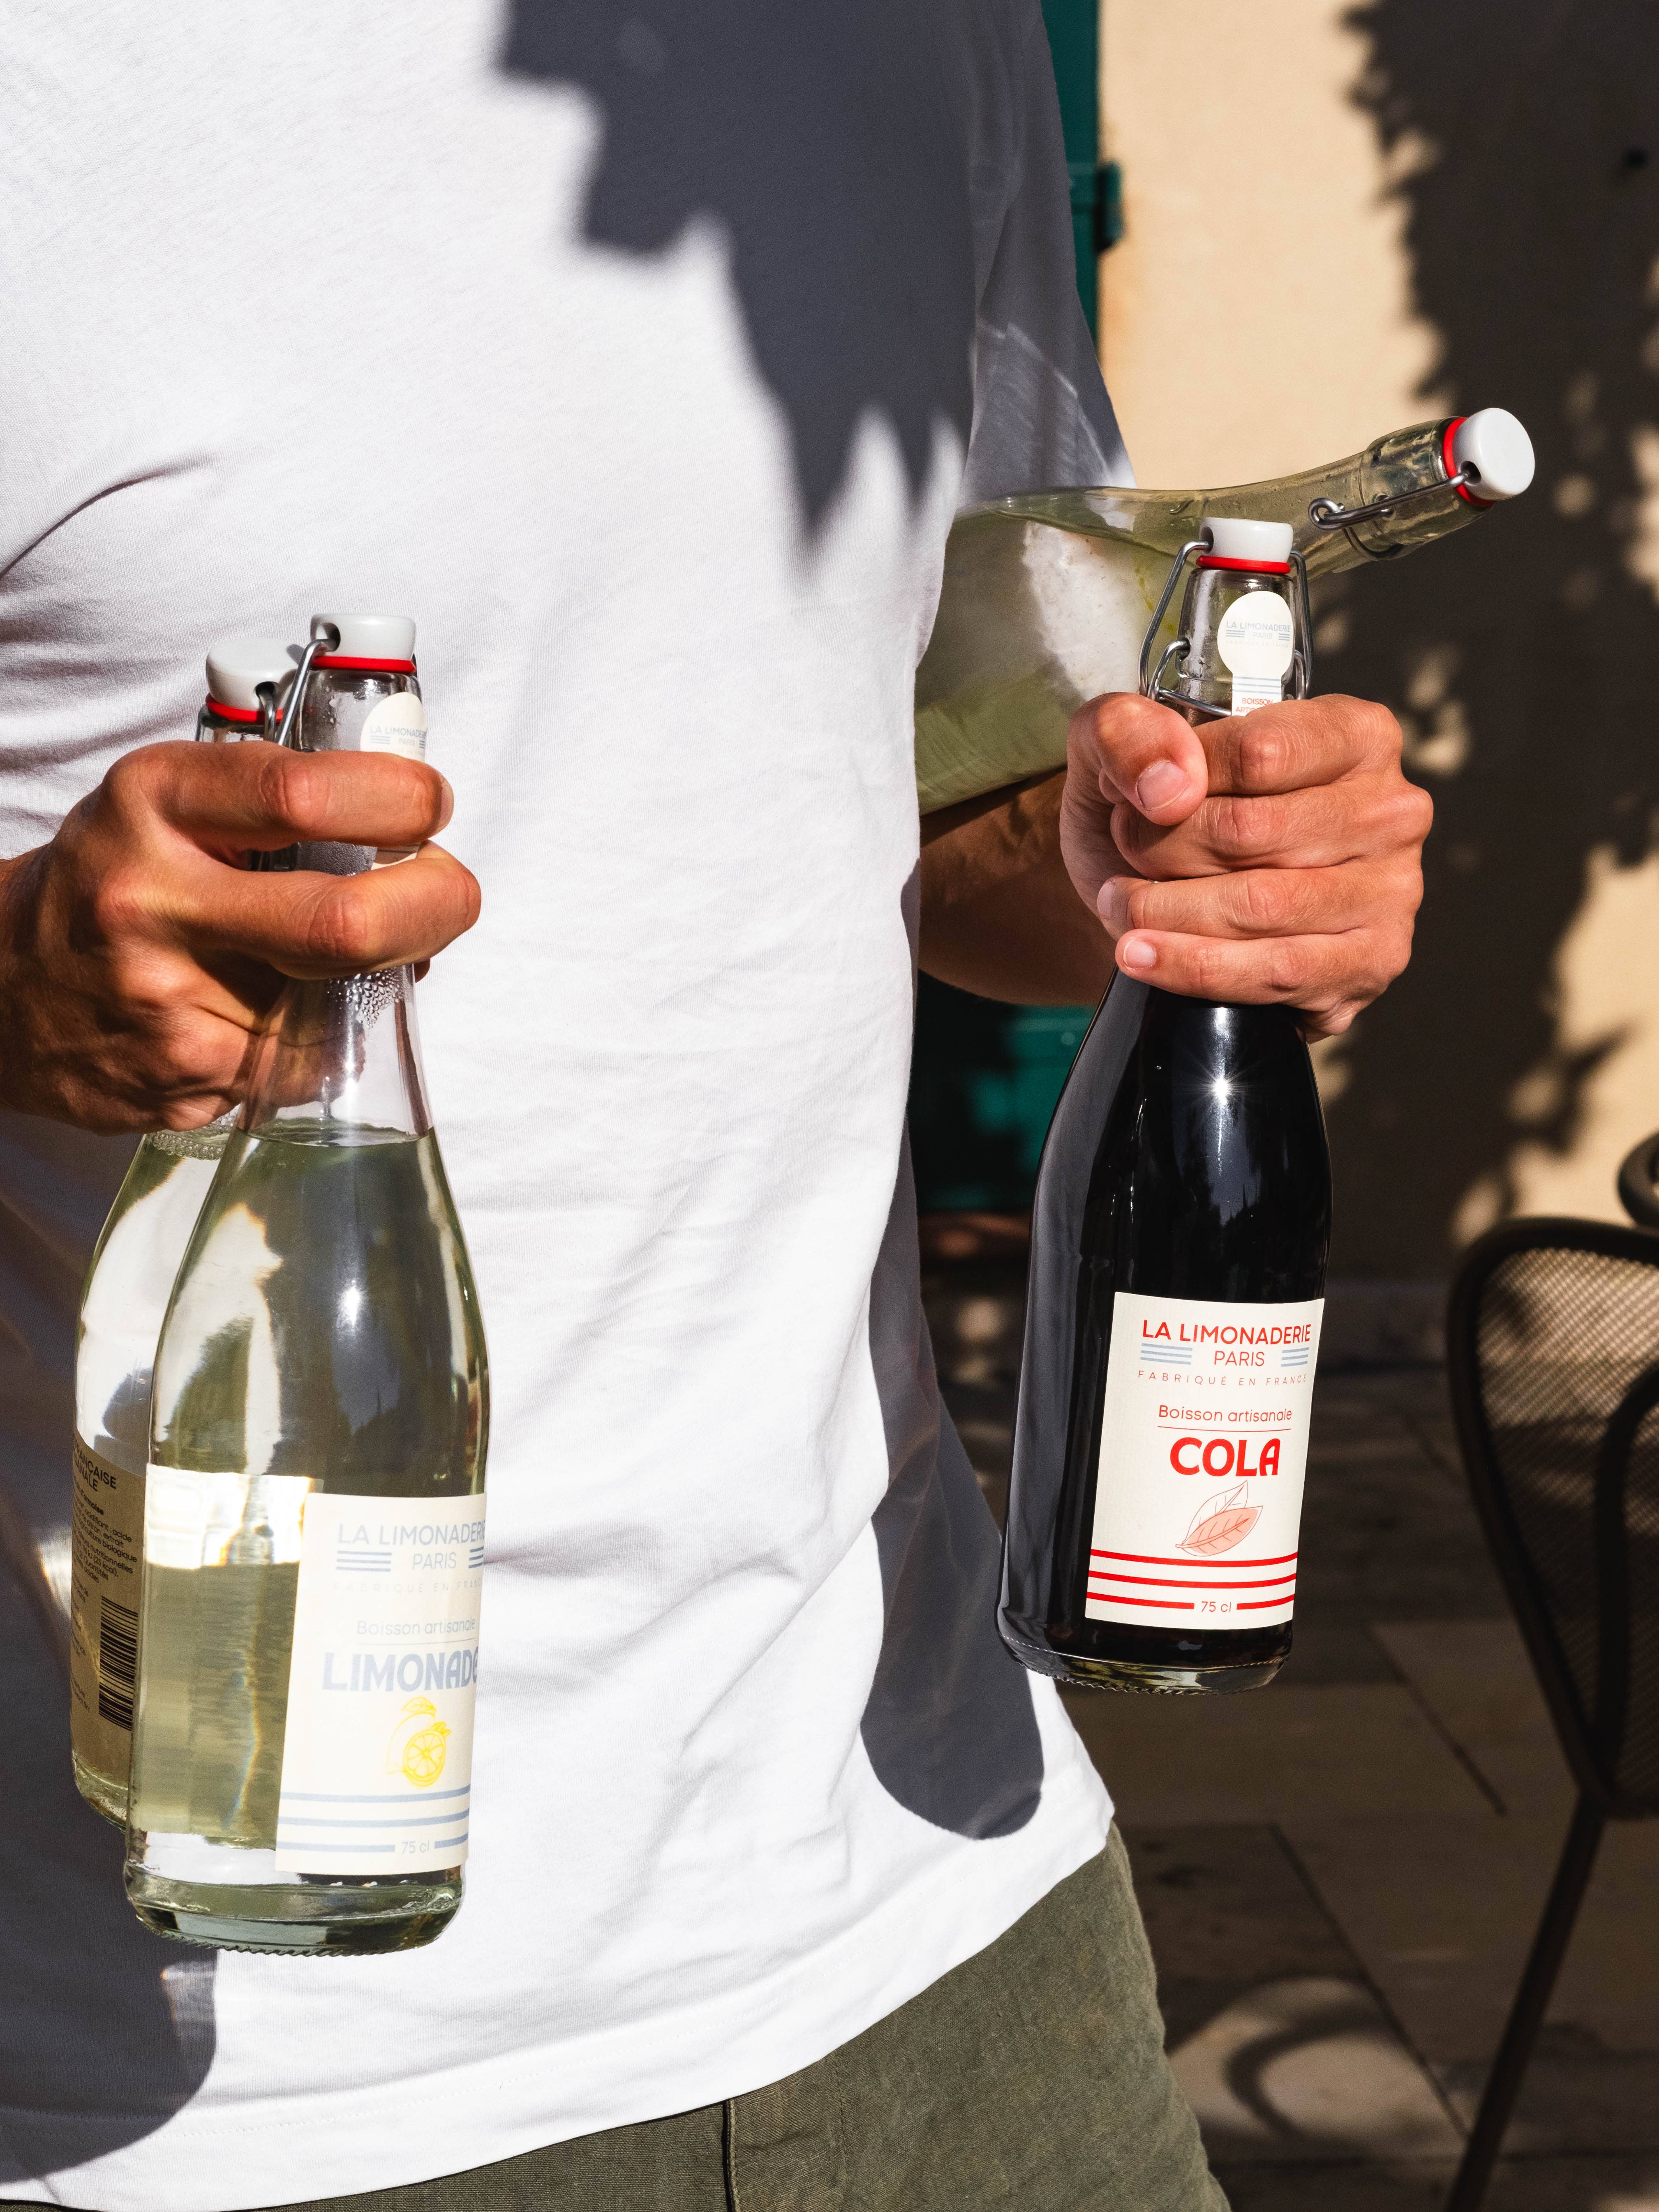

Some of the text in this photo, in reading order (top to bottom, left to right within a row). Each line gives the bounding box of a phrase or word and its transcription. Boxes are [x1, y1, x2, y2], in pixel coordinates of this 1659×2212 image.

[1240, 621, 1291, 632] LIMONADERIE
[370, 725, 381, 734] LA
[1142, 1319, 1311, 1345] LA LIMONADERIE
[1213, 1350, 1265, 1367] PARIS
[1138, 1369, 1307, 1387] FABRIQUÉ EN FRANCE
[1158, 1405, 1292, 1423] Boisson artisanale
[1169, 1436, 1281, 1478] COLA
[103, 1532, 124, 1549] extrait
[113, 1529, 132, 1542] acide
[337, 1524, 369, 1545] LA
[102, 1541, 137, 1563] biologique
[412, 1552, 457, 1570] PARIS
[434, 1582, 448, 1592] EN
[1200, 1601, 1232, 1613] 75 cl
[357, 1618, 475, 1635] Boisson artisanale
[401, 1840, 430, 1854] 75 cl
